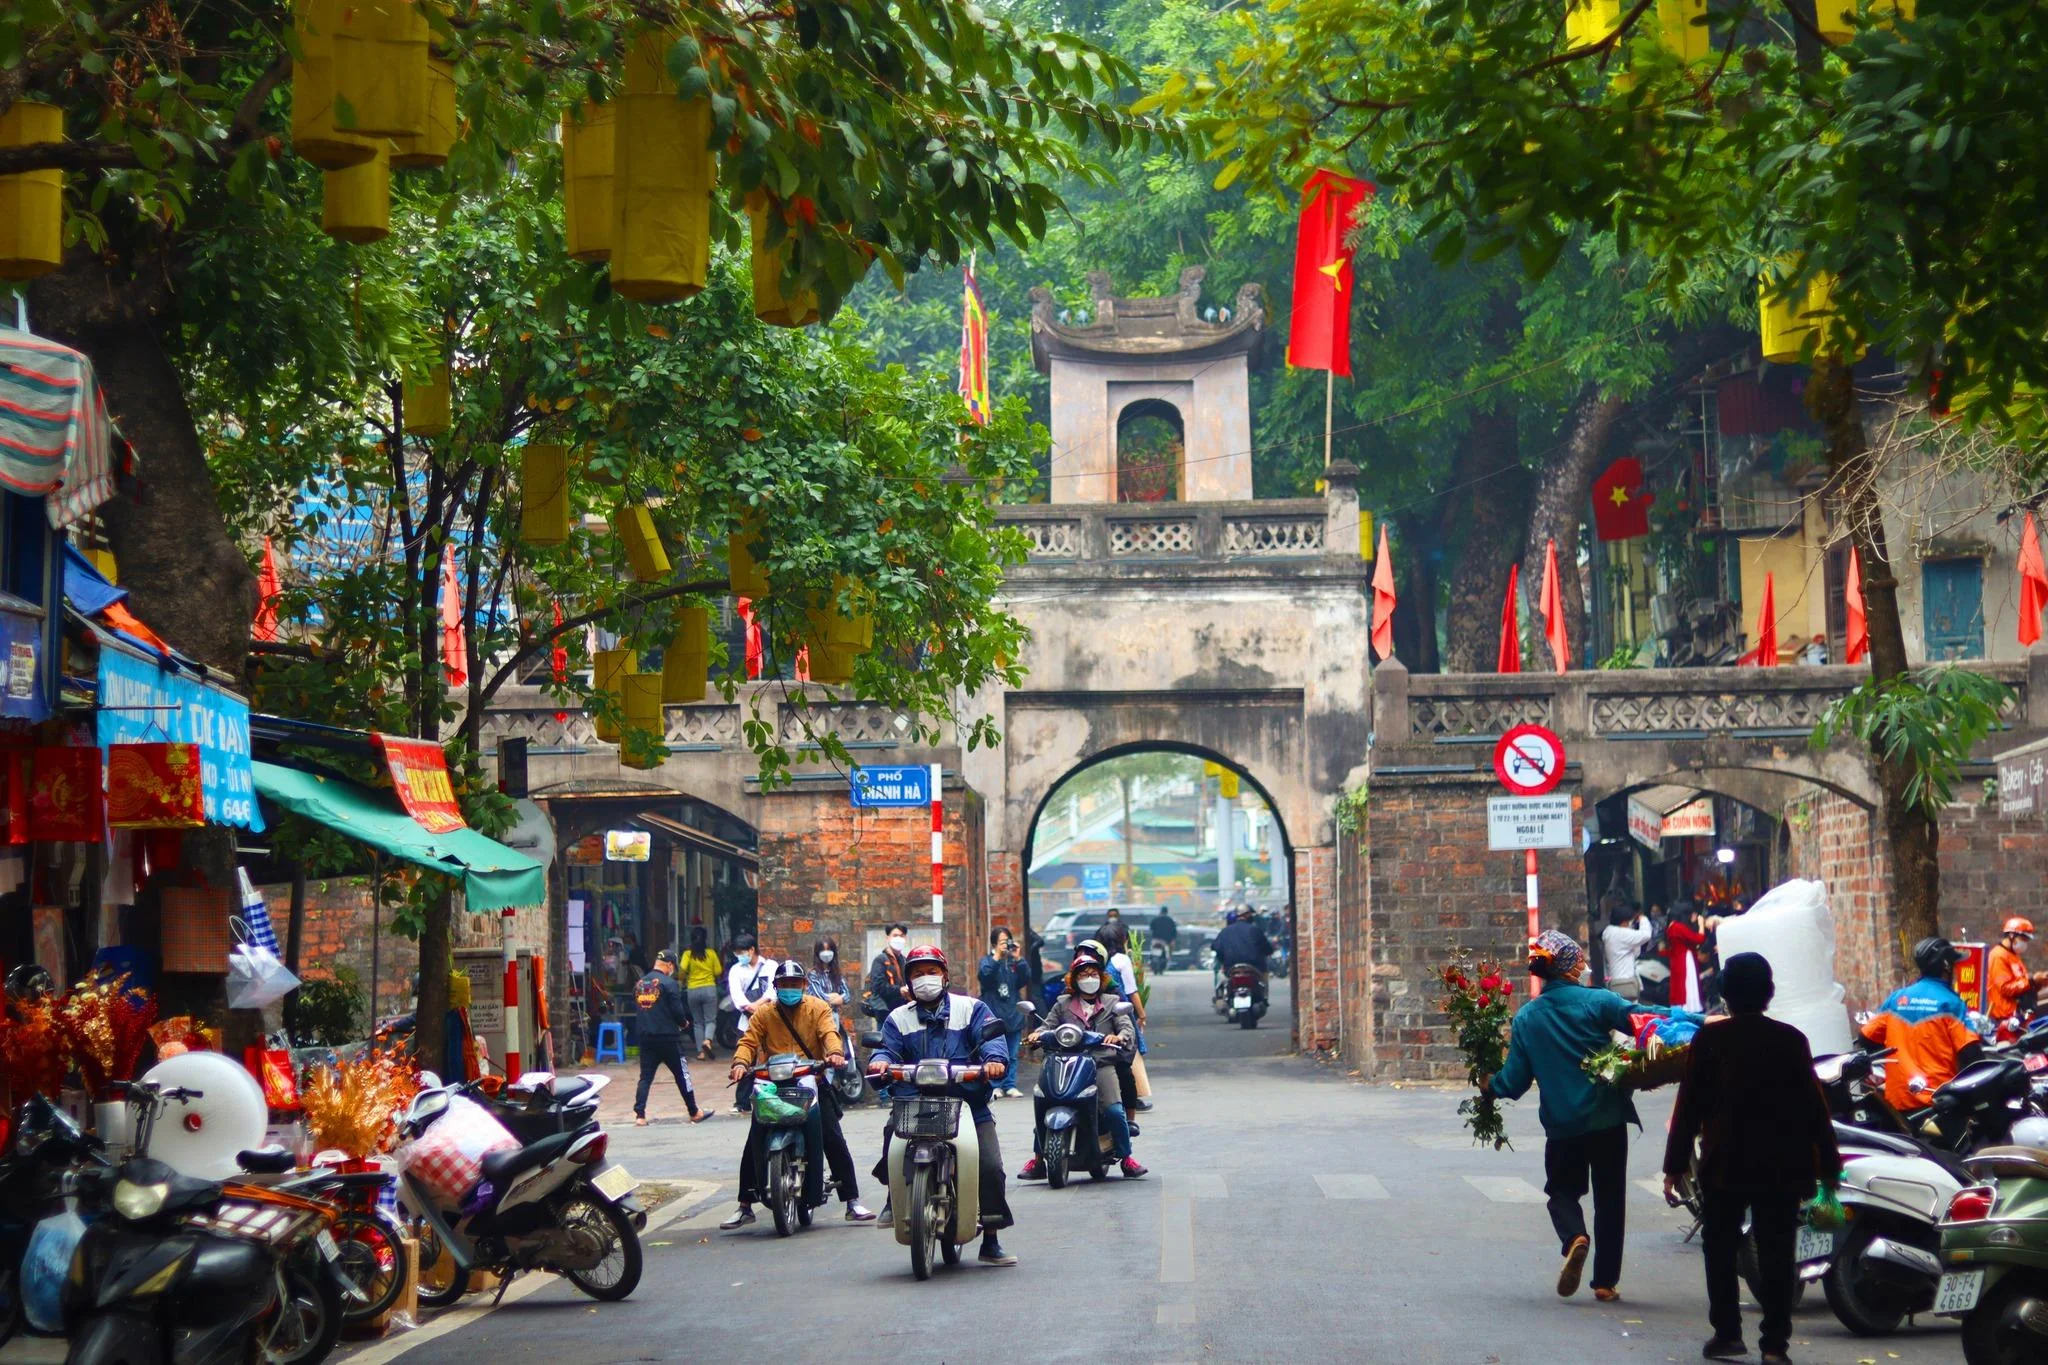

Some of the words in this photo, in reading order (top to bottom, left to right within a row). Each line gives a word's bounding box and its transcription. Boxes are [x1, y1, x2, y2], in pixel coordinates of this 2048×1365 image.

[878, 770, 902, 781] PHỐ
[904, 782, 921, 799] HÀ
[1944, 1274, 1976, 1292] 30-F4
[1940, 1292, 1972, 1311] 4669
